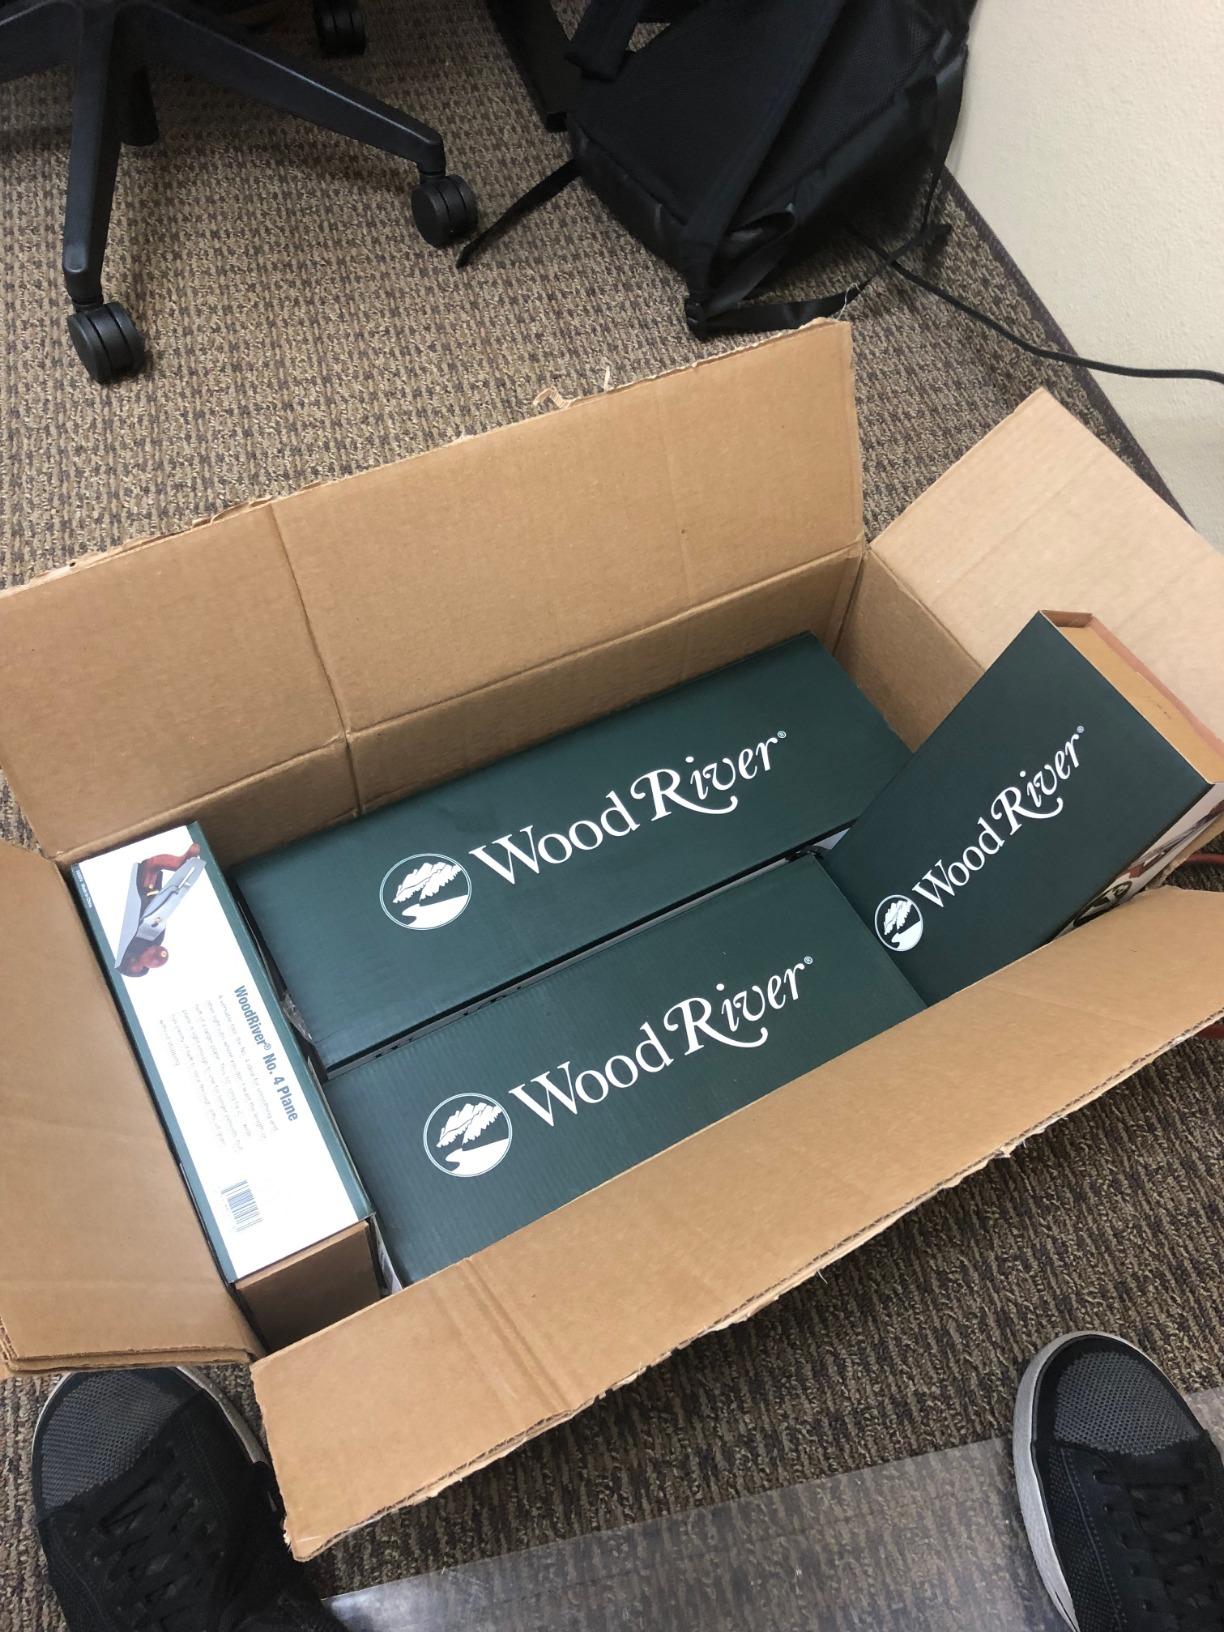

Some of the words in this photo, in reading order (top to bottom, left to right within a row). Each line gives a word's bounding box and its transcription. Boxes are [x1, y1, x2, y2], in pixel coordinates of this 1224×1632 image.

[263, 1053, 277, 1075] No.
[273, 1076, 285, 1086] 4
[276, 1086, 298, 1121] Plane
